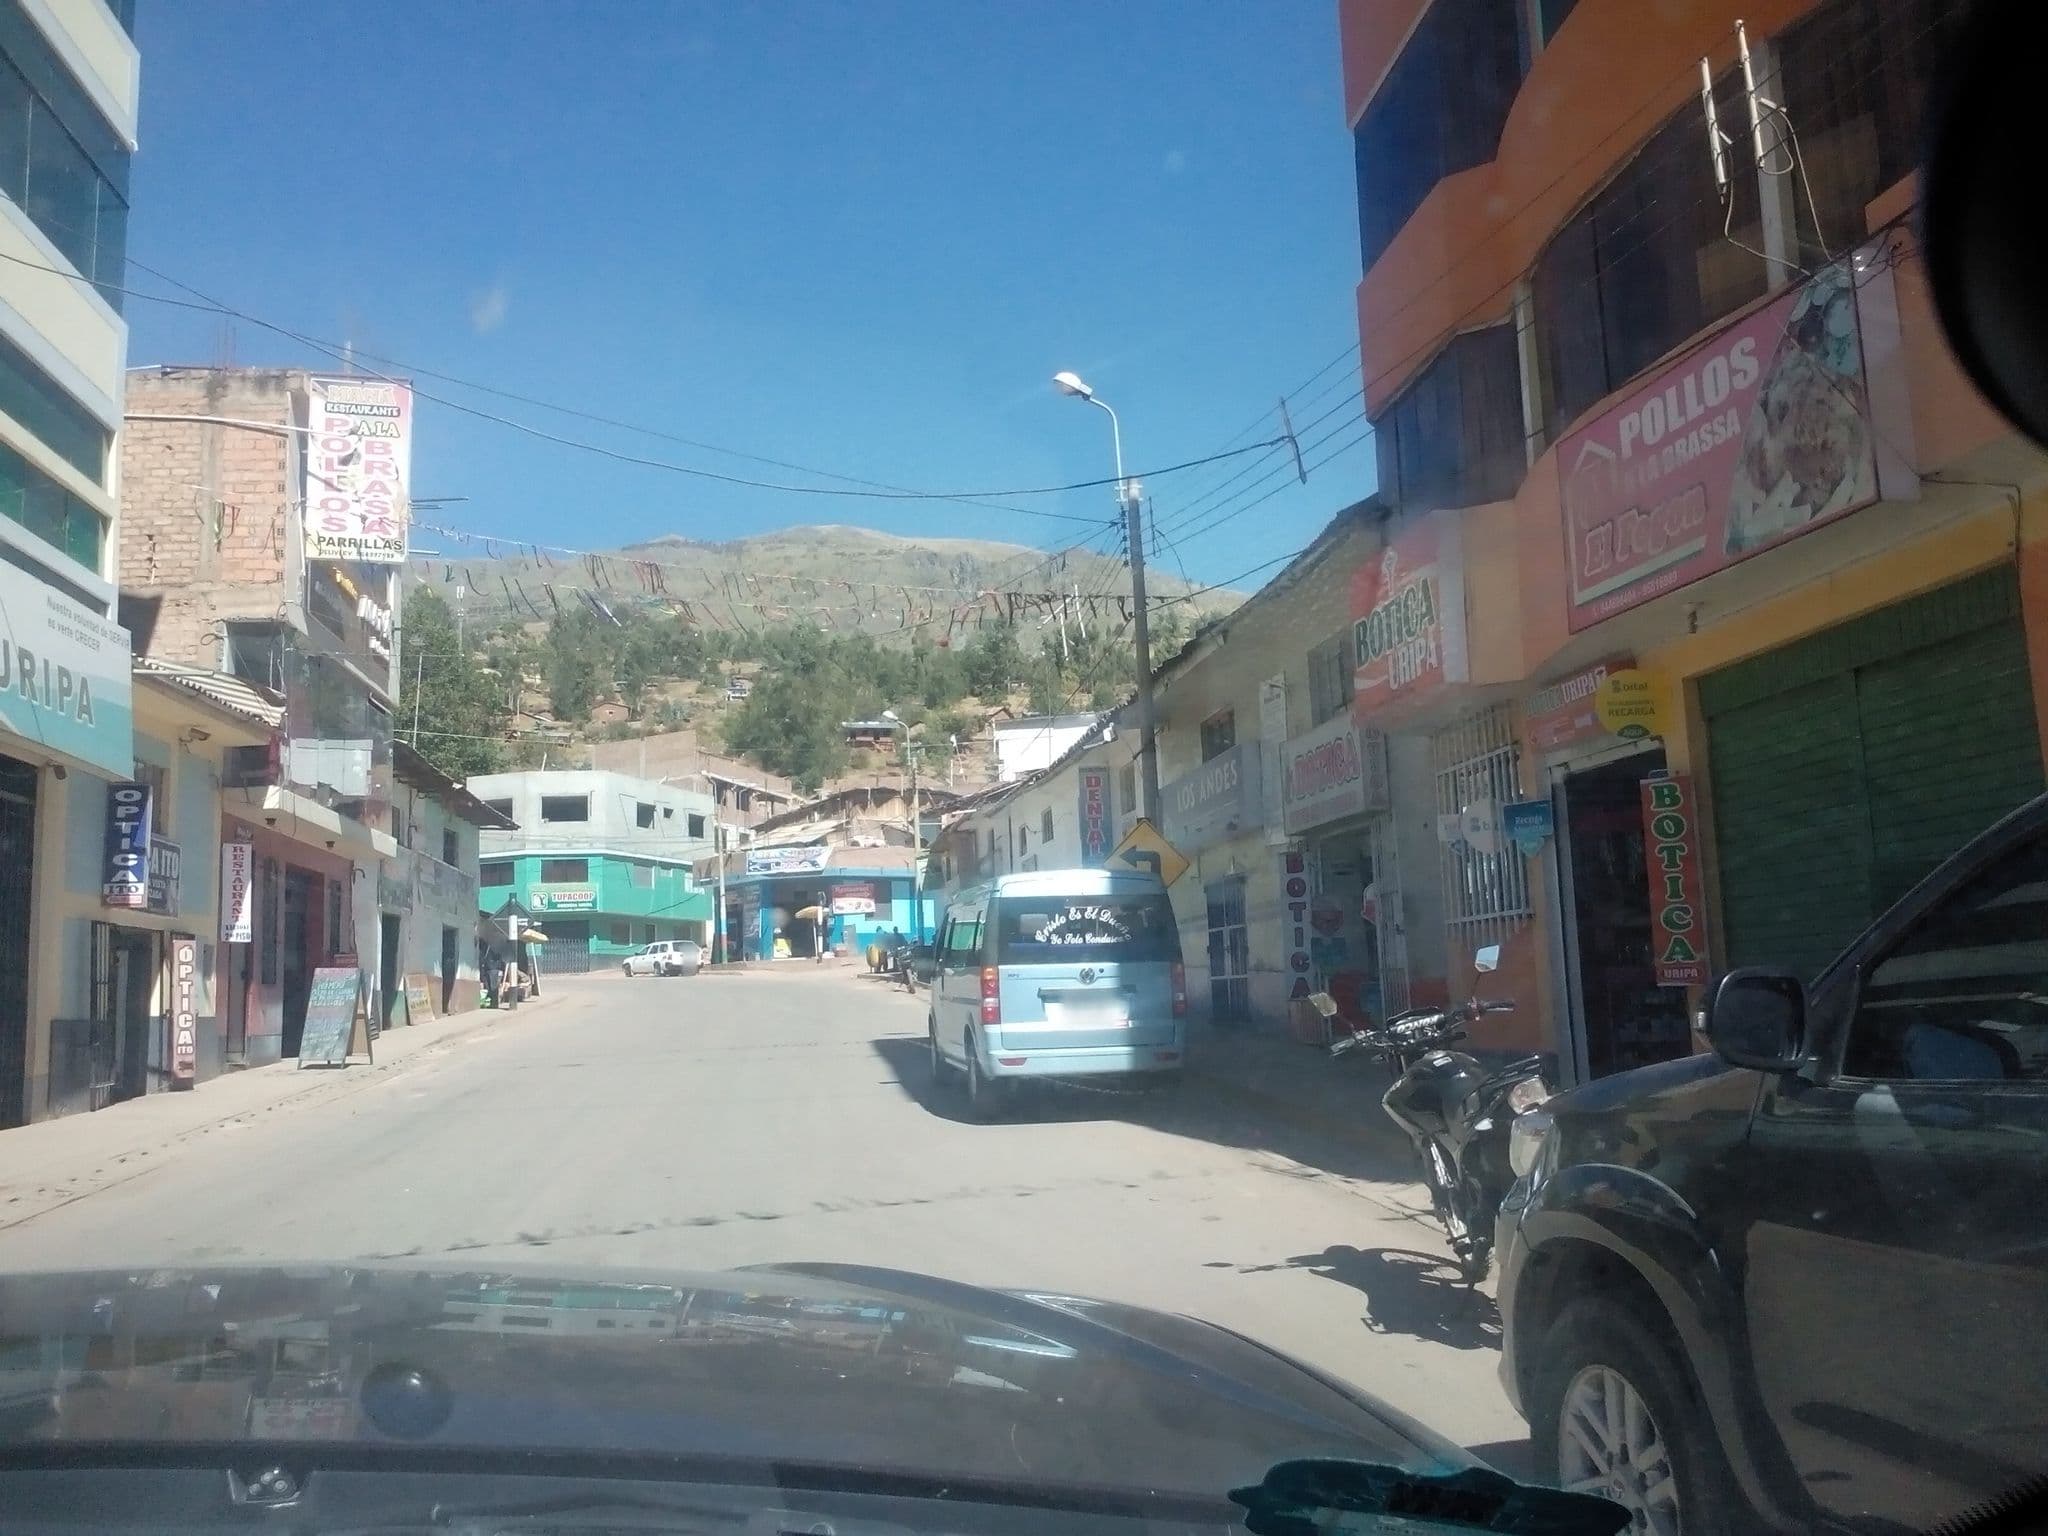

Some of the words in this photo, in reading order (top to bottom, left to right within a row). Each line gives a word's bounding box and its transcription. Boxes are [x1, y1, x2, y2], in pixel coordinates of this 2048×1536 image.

[326, 403, 400, 416] RESTAURANTE
[1619, 337, 1760, 458] POLLOS
[1662, 408, 1742, 475] BRASSA
[317, 535, 403, 550] PARRILLAS
[1354, 577, 1436, 671] BOTICA
[1387, 628, 1438, 690] URIPA
[1560, 671, 1598, 703] URIPA
[1085, 775, 1105, 857] DENTAL
[1176, 783, 1196, 814] LOS
[1199, 758, 1238, 804] ANDES
[111, 789, 143, 882] OPTICA
[231, 846, 245, 923] RESTAURANT
[1649, 783, 1701, 964] BOTICA
[1050, 933, 1062, 945] Yo
[1068, 907, 1082, 921] Es
[1084, 906, 1098, 920] El
[1285, 853, 1312, 999] BOTICA
[178, 944, 194, 1045] ÓPTICA
[177, 1046, 193, 1055] ITO
